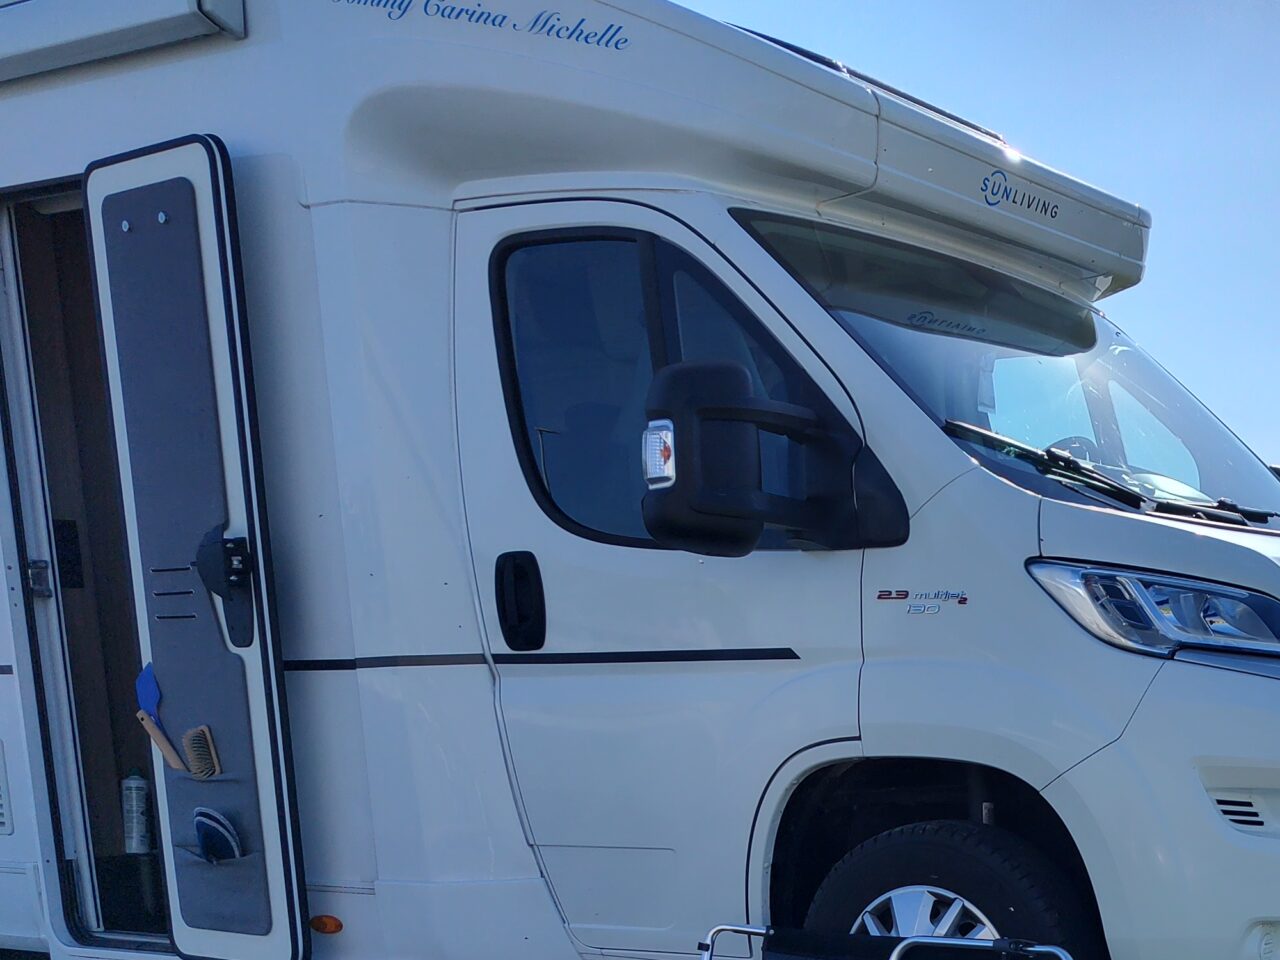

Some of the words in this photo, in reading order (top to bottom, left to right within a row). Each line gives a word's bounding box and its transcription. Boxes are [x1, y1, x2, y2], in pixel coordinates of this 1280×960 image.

[423, 0, 508, 28] Carina
[512, 9, 632, 51] Michelle
[980, 170, 1059, 219] SUNLIVING
